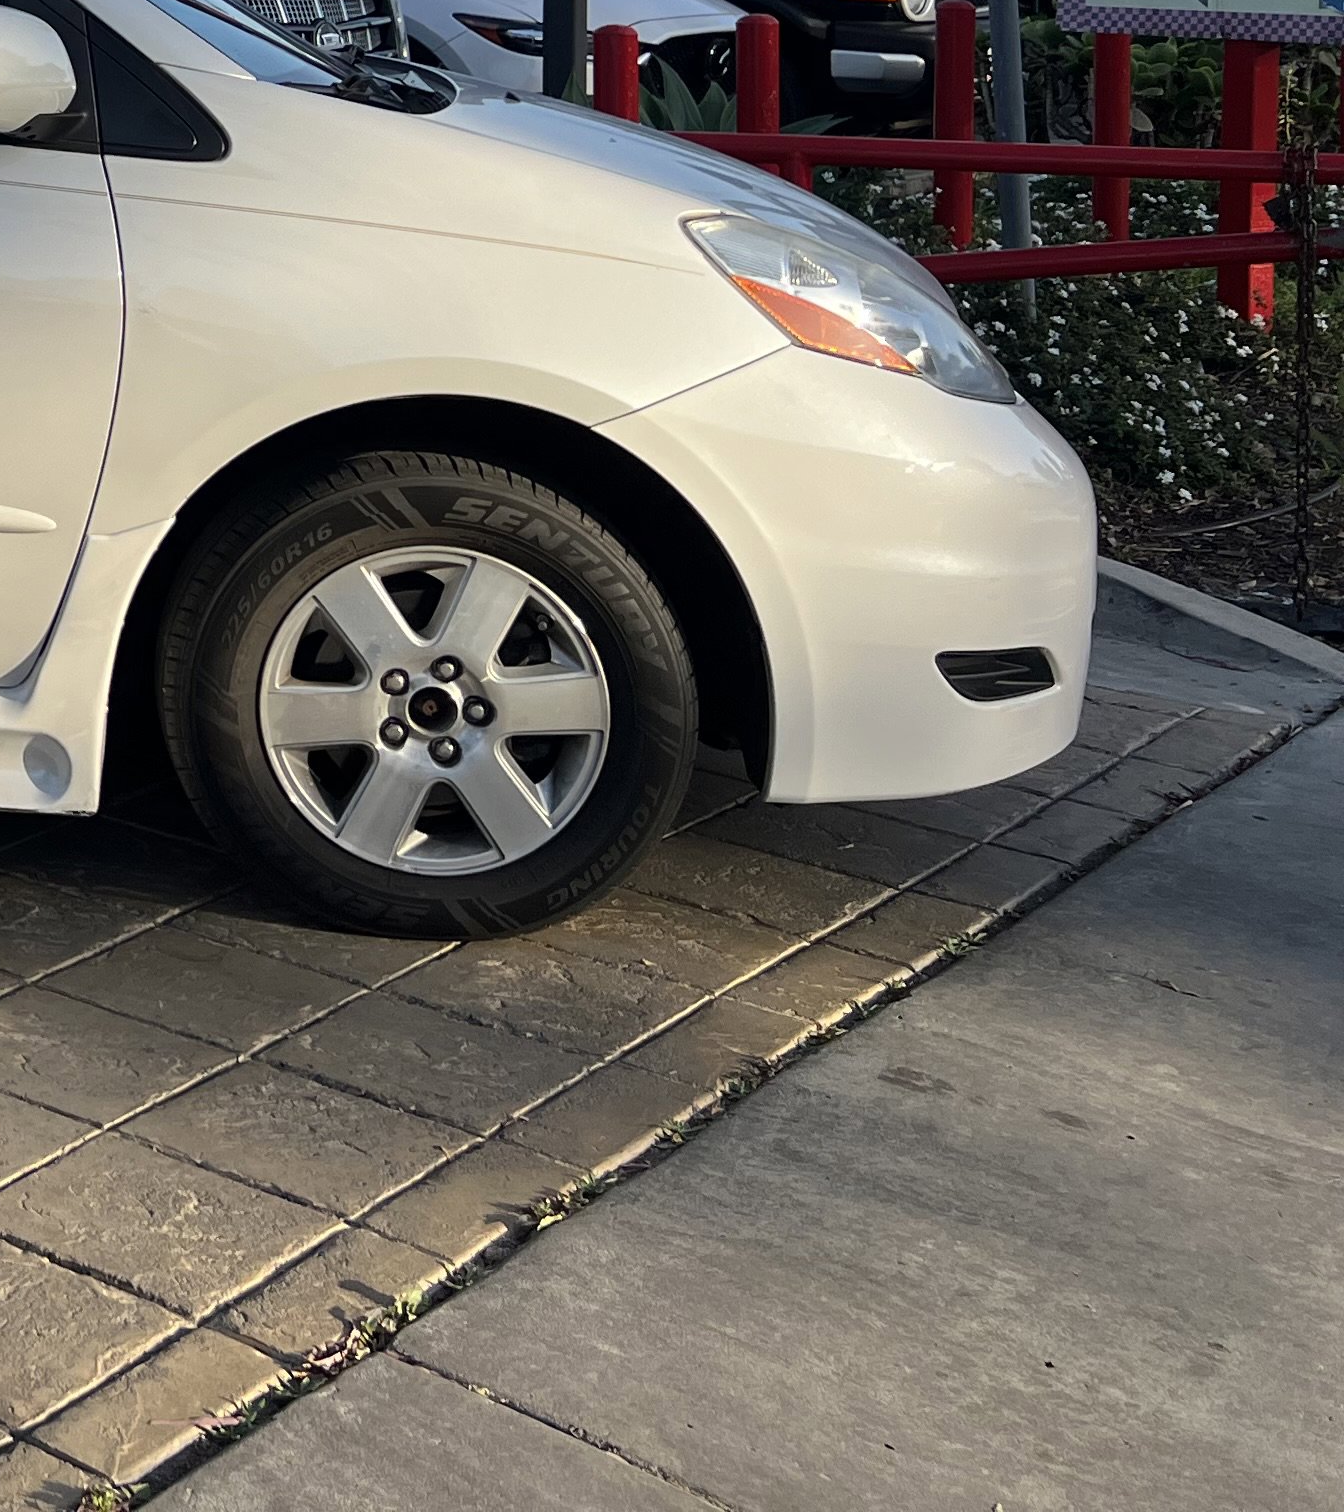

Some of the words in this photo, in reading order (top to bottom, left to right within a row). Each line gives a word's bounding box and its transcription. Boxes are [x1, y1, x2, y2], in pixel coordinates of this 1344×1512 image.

[221, 522, 334, 651] 225/60R16
[443, 496, 669, 672] SENTURY
[546, 785, 661, 912] TOURING
